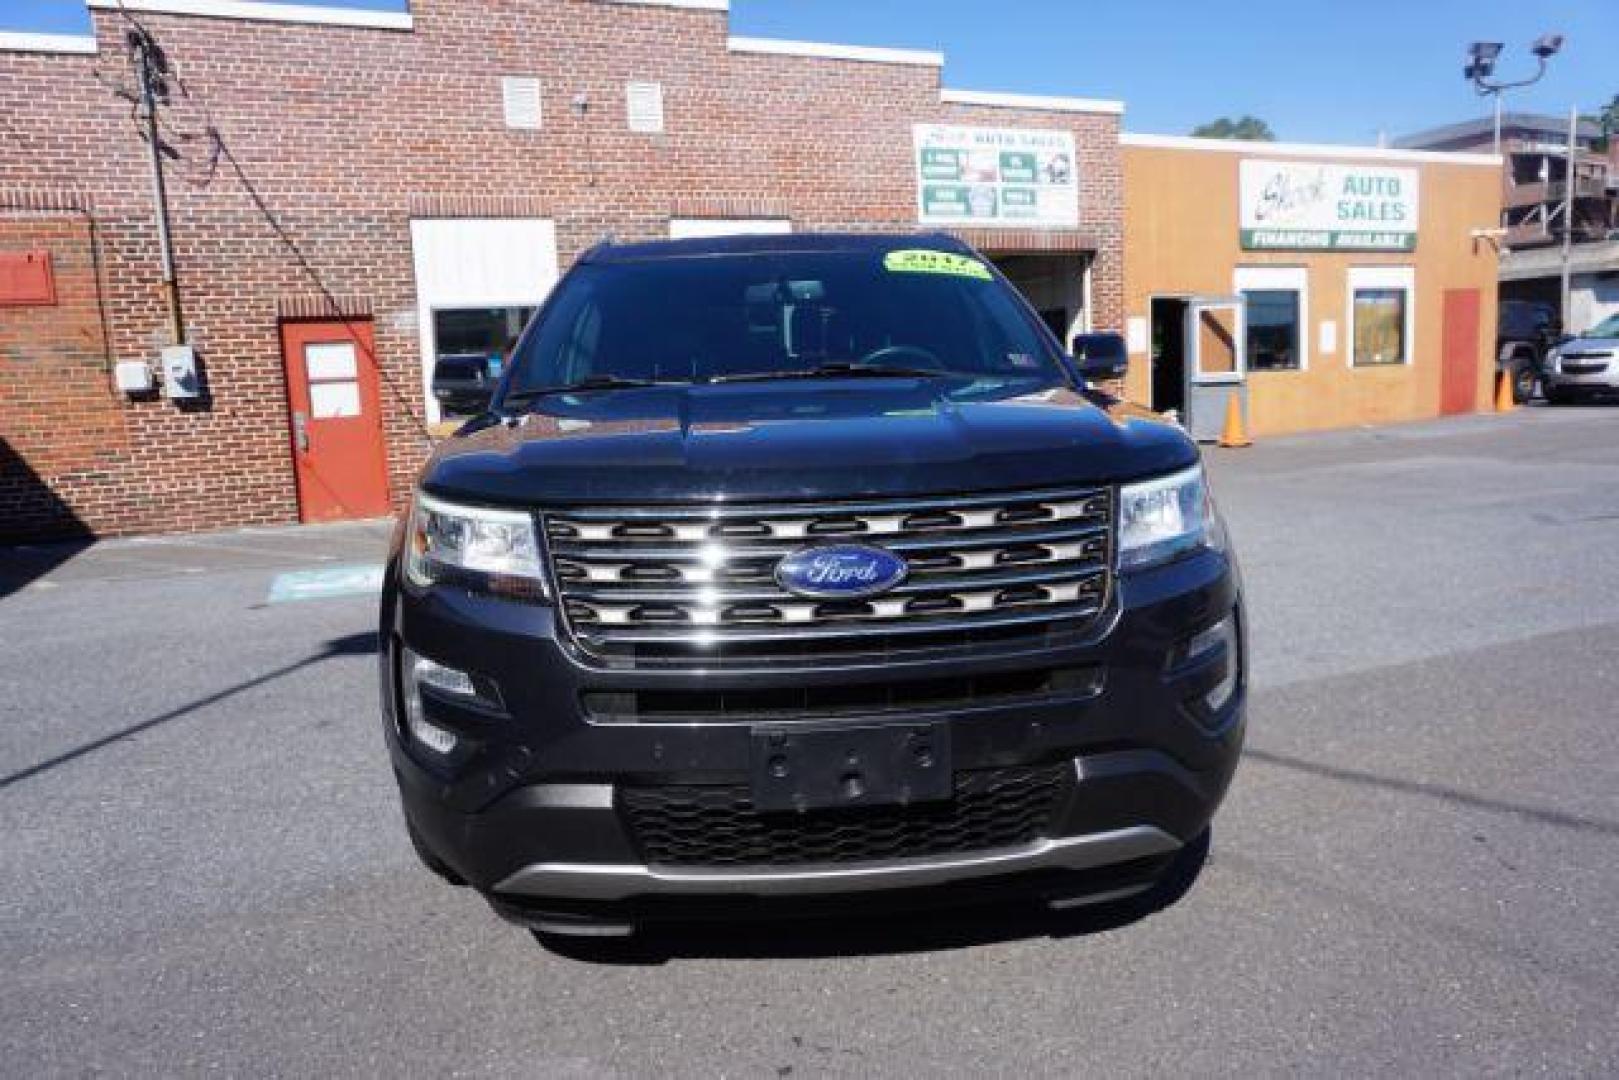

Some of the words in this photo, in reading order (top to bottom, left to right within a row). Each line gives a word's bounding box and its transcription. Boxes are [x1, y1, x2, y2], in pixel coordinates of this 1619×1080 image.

[1343, 175, 1401, 197] AUTO
[1337, 201, 1405, 221] SALES
[807, 555, 879, 583] Ford
